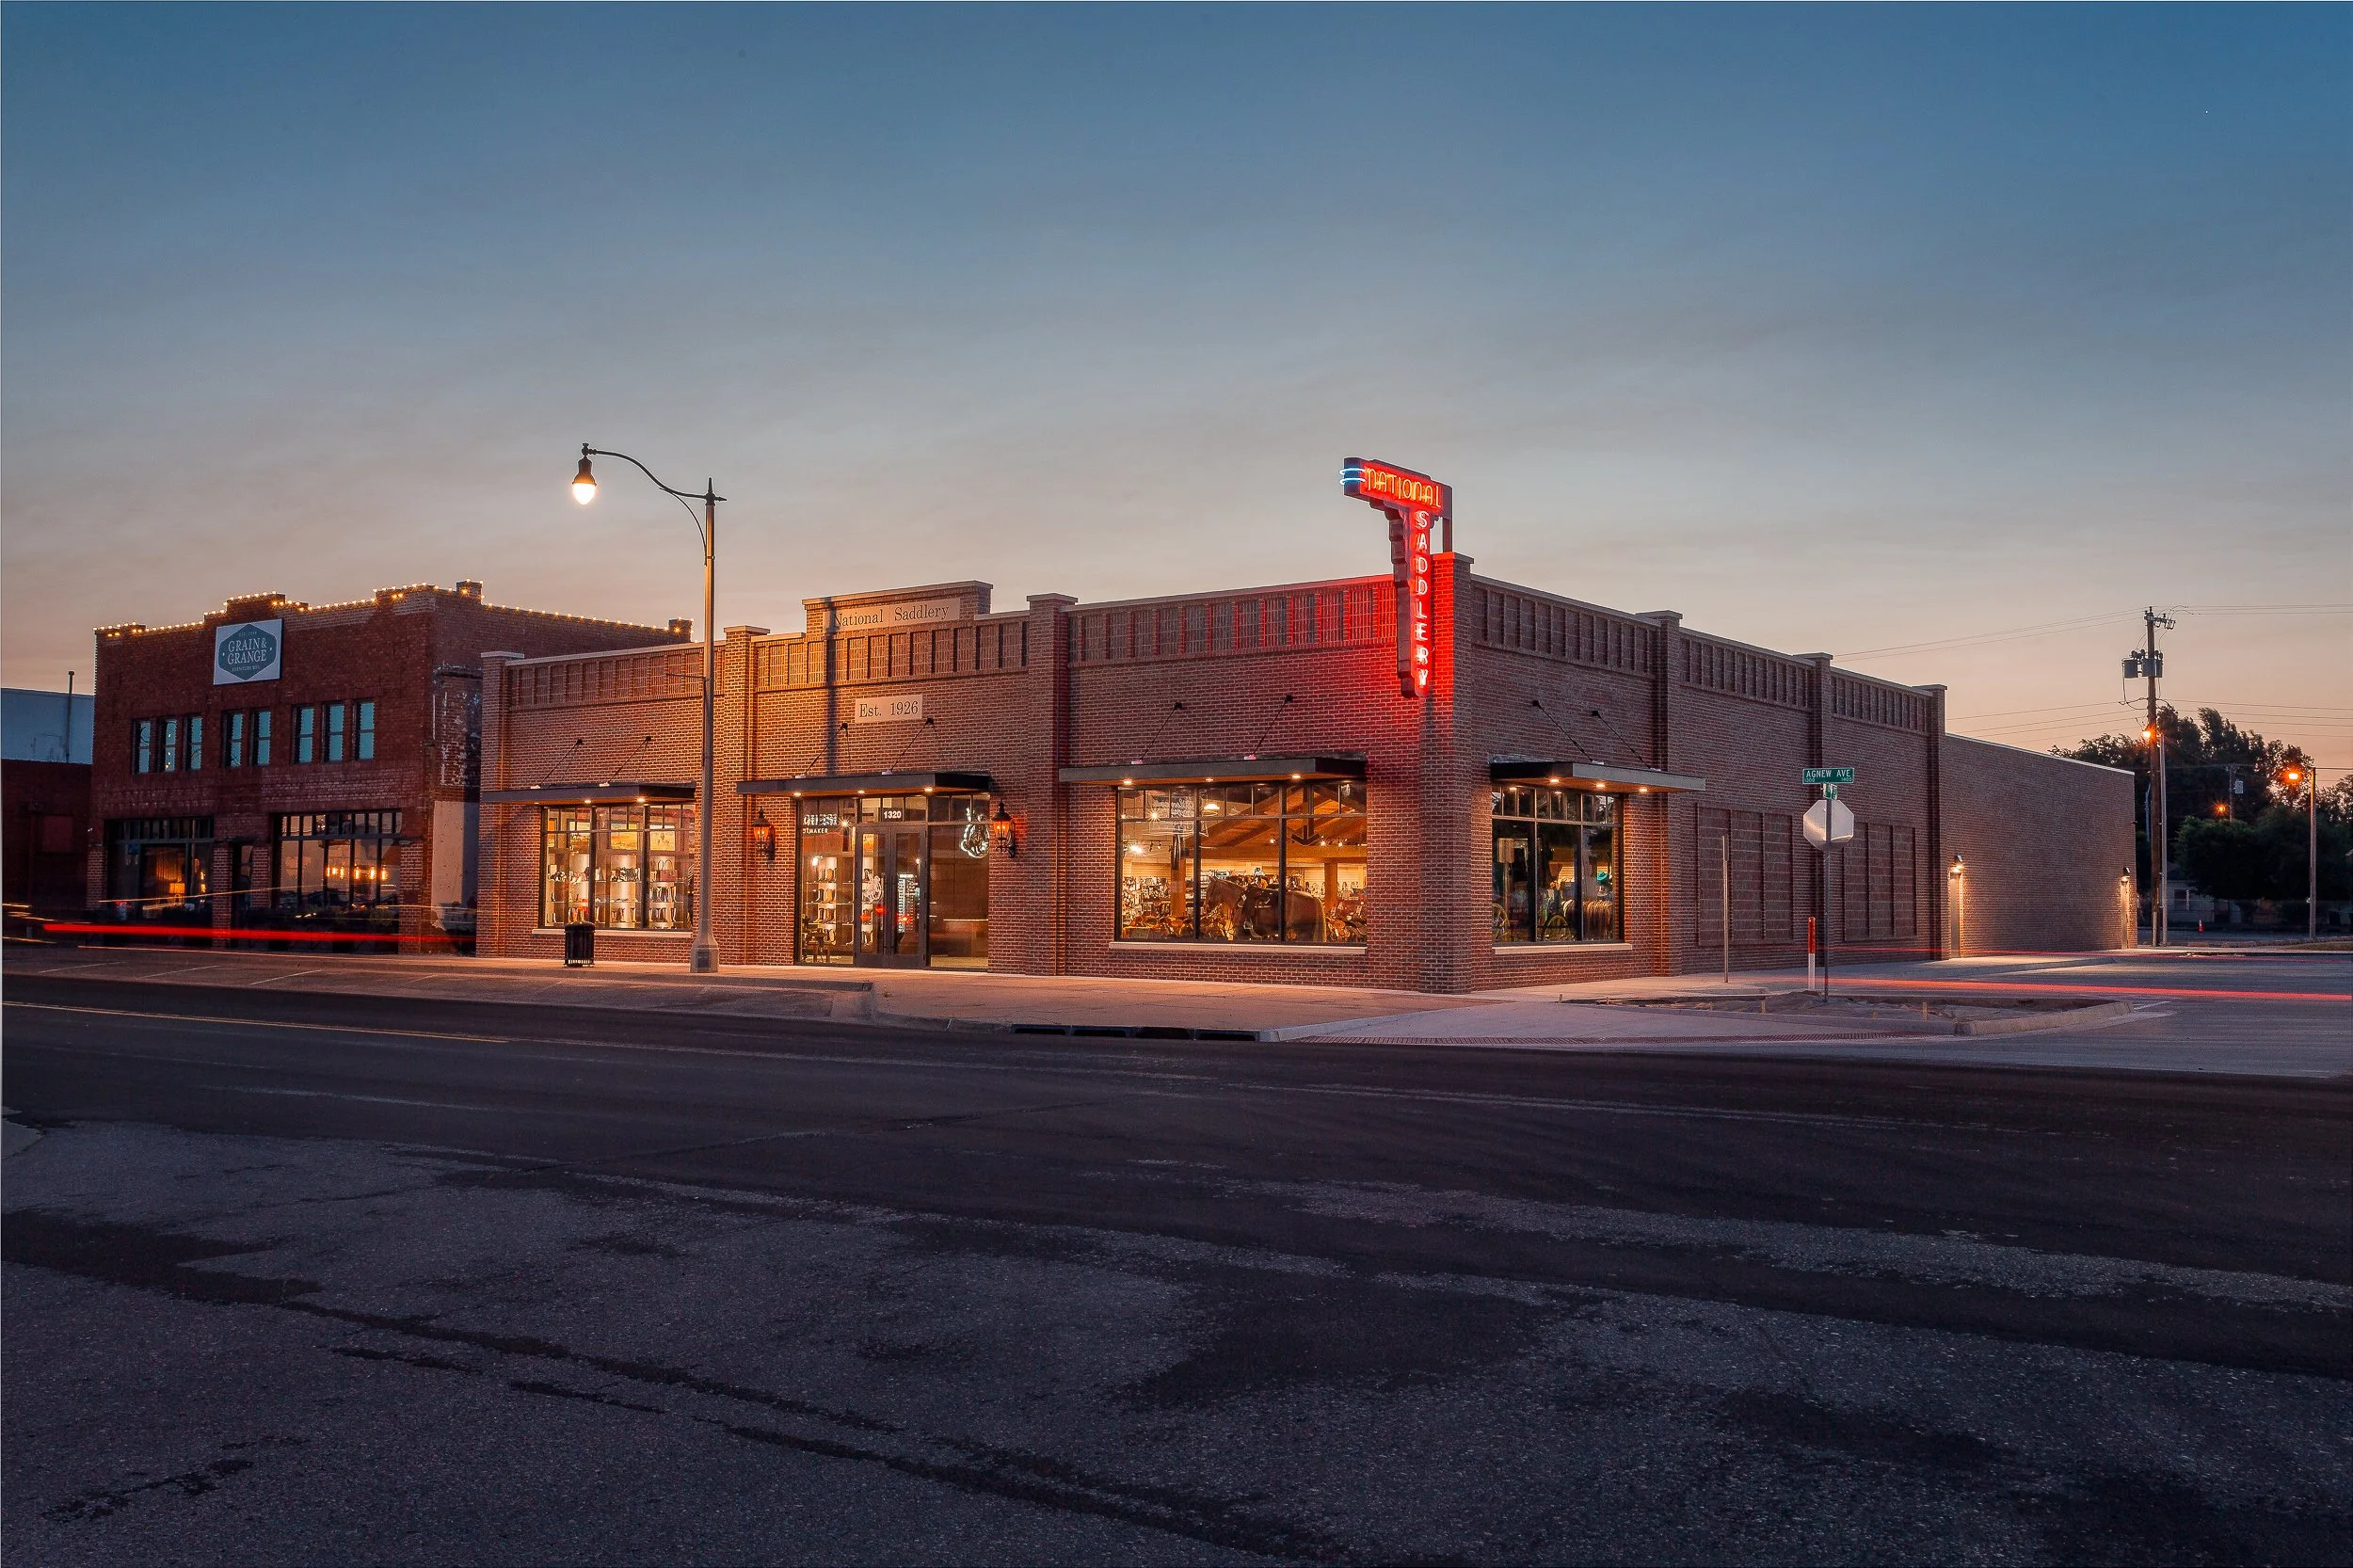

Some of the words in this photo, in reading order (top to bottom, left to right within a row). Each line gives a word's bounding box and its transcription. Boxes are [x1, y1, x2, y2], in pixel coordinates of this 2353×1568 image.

[1366, 467, 1441, 508] NATIONAL
[1415, 510, 1430, 687] SADDLERY
[834, 609, 884, 628] National
[894, 604, 950, 621] Saddlery
[228, 638, 260, 652] GRAIN
[227, 649, 267, 664] GRANGE
[859, 703, 882, 718] Est.
[889, 700, 919, 716] 1926
[1805, 770, 1832, 778] AGNEW
[883, 810, 902, 819] 1320
